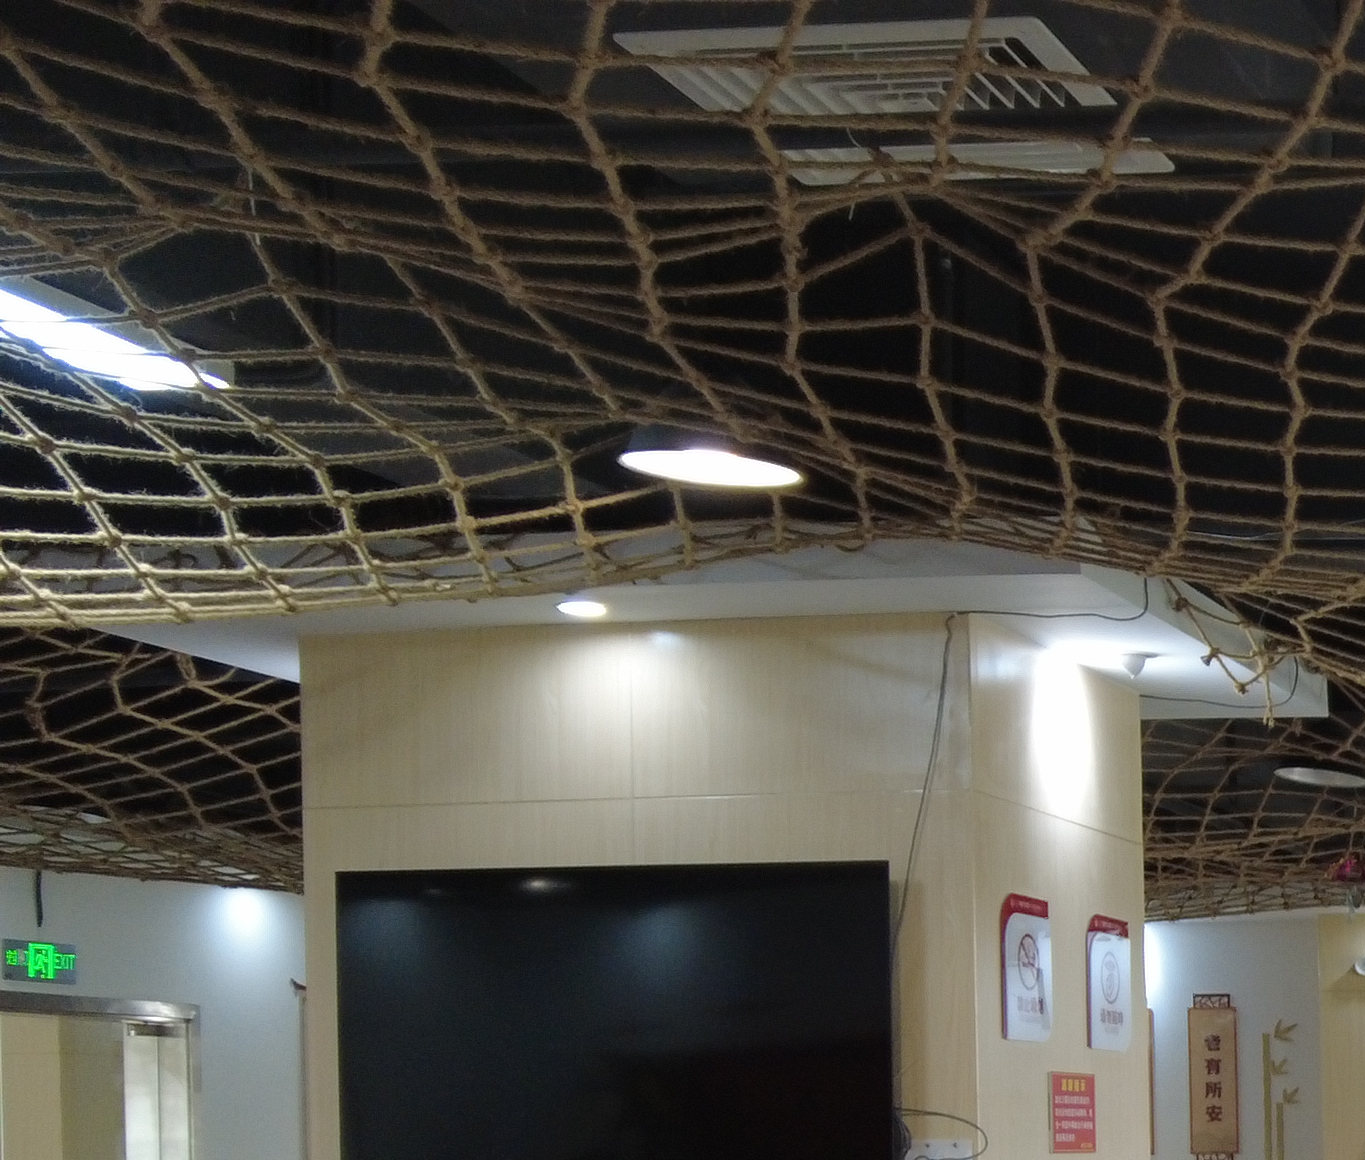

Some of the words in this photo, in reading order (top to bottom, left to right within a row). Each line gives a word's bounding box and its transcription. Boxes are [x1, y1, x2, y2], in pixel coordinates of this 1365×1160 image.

[54, 953, 77, 970] EXIT
[1203, 1033, 1223, 1123] 老有所安
